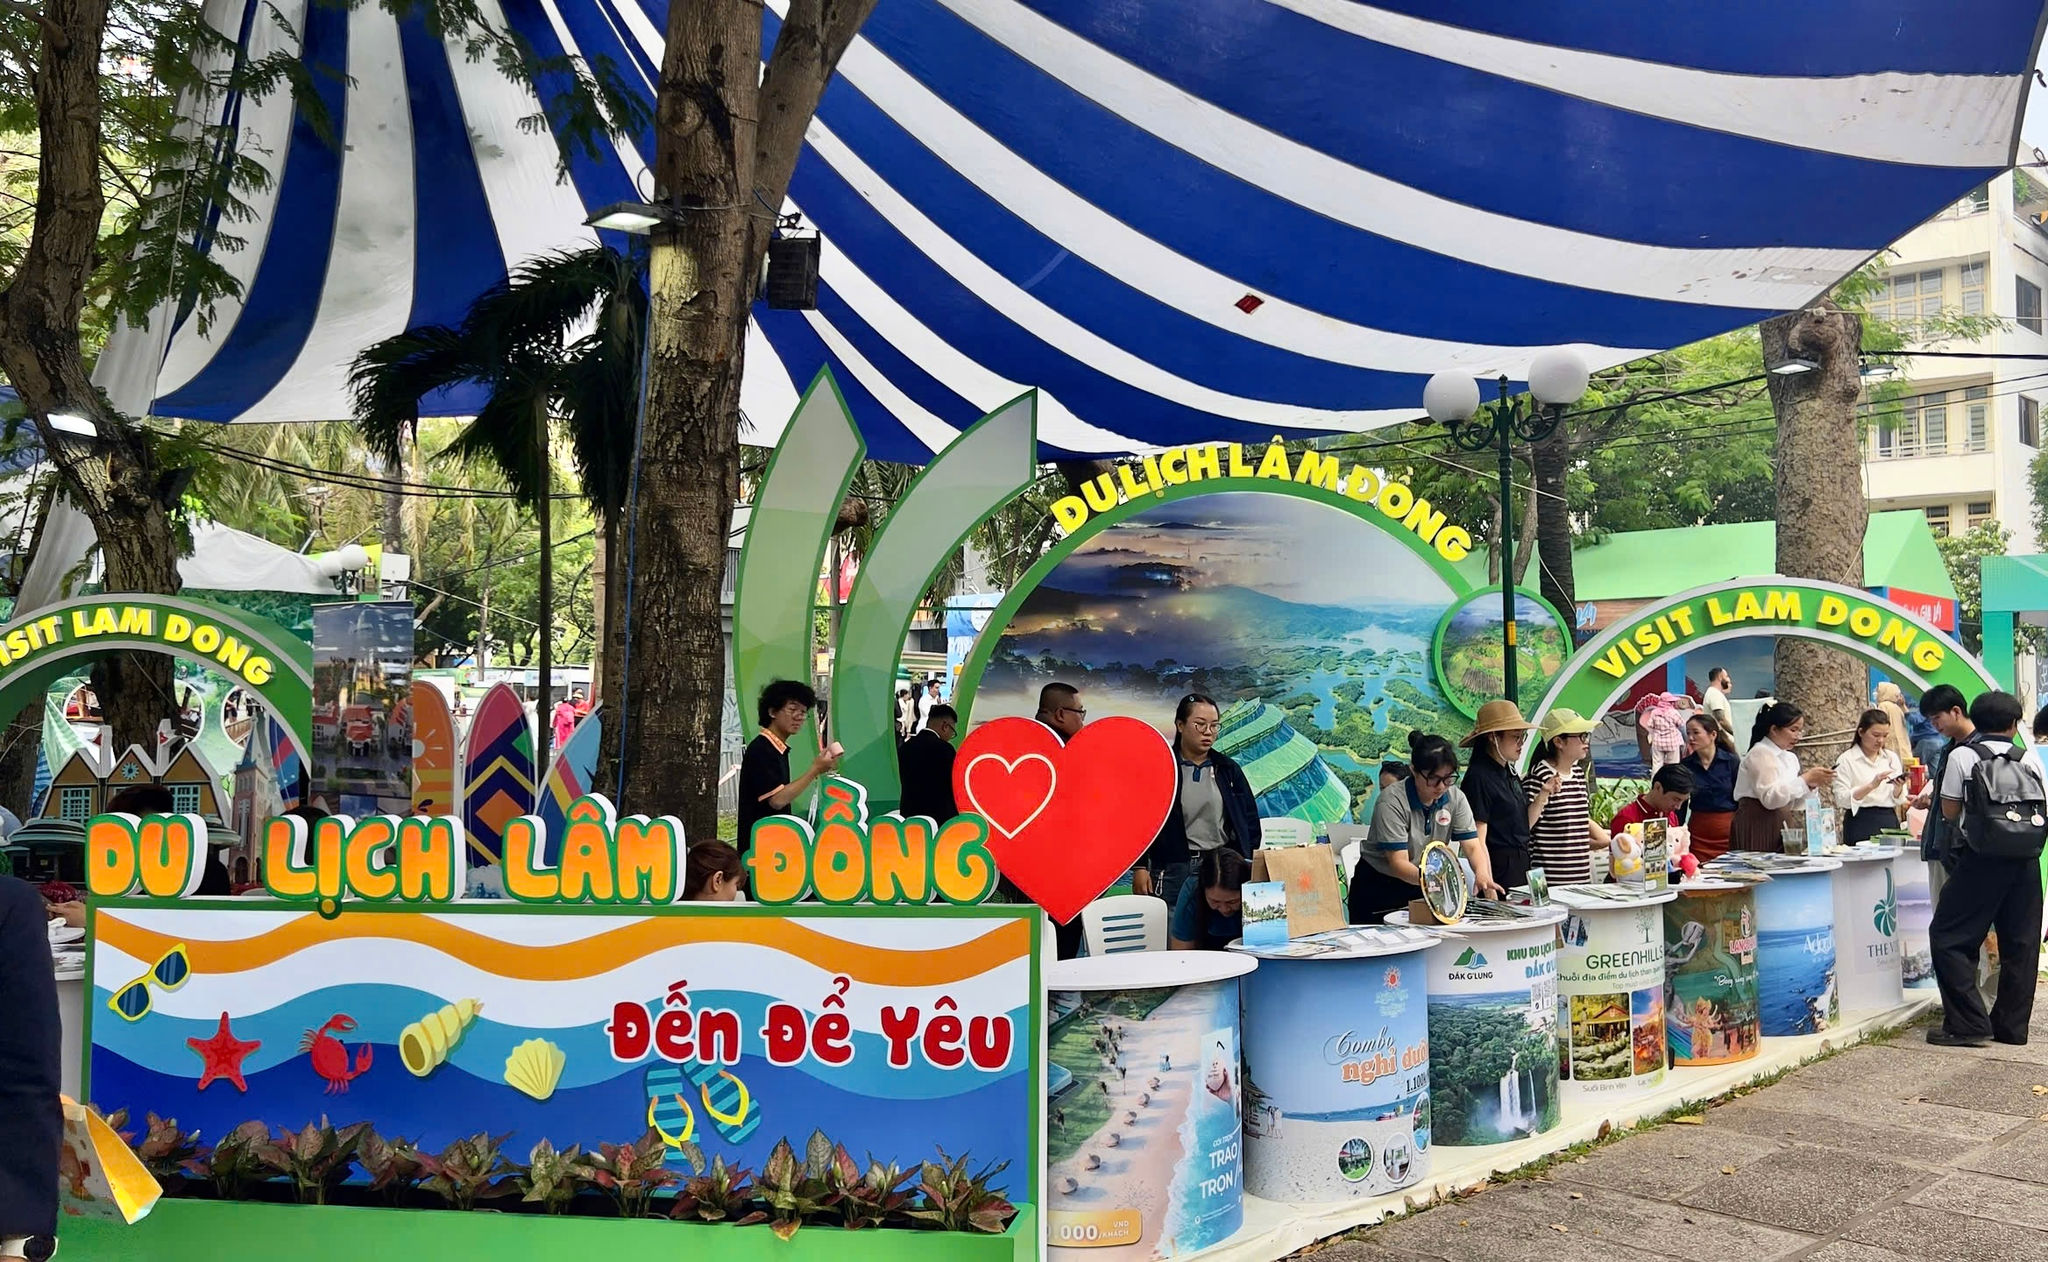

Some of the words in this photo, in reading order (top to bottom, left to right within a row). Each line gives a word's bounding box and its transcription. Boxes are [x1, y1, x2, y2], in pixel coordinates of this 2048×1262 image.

[1050, 473, 1118, 535] DU
[1118, 444, 1221, 499] LỊCH
[1228, 434, 1340, 492] LÂM
[0, 615, 63, 667] ISIT
[72, 607, 156, 638] LAM
[163, 614, 277, 686] DONG
[1593, 605, 1696, 680] VISIT
[1706, 591, 1803, 628] LAM
[1817, 595, 1945, 672] DONG
[85, 812, 208, 899] DU
[262, 814, 466, 921] LỊCH
[502, 792, 688, 906] LÂM
[741, 775, 1000, 907] ĐỒNG
[1506, 947, 1528, 961] KHU
[1529, 945, 1540, 958] DU
[1867, 943, 1888, 957] THE
[606, 978, 741, 1063] Đến
[761, 975, 853, 1065] Để
[879, 994, 1012, 1070] Yêu
[1323, 1024, 1395, 1066] Combo
[1341, 1046, 1398, 1087] nghỉ
[1208, 1141, 1238, 1170] TRAO
[1199, 1169, 1233, 1200] TRỌN
